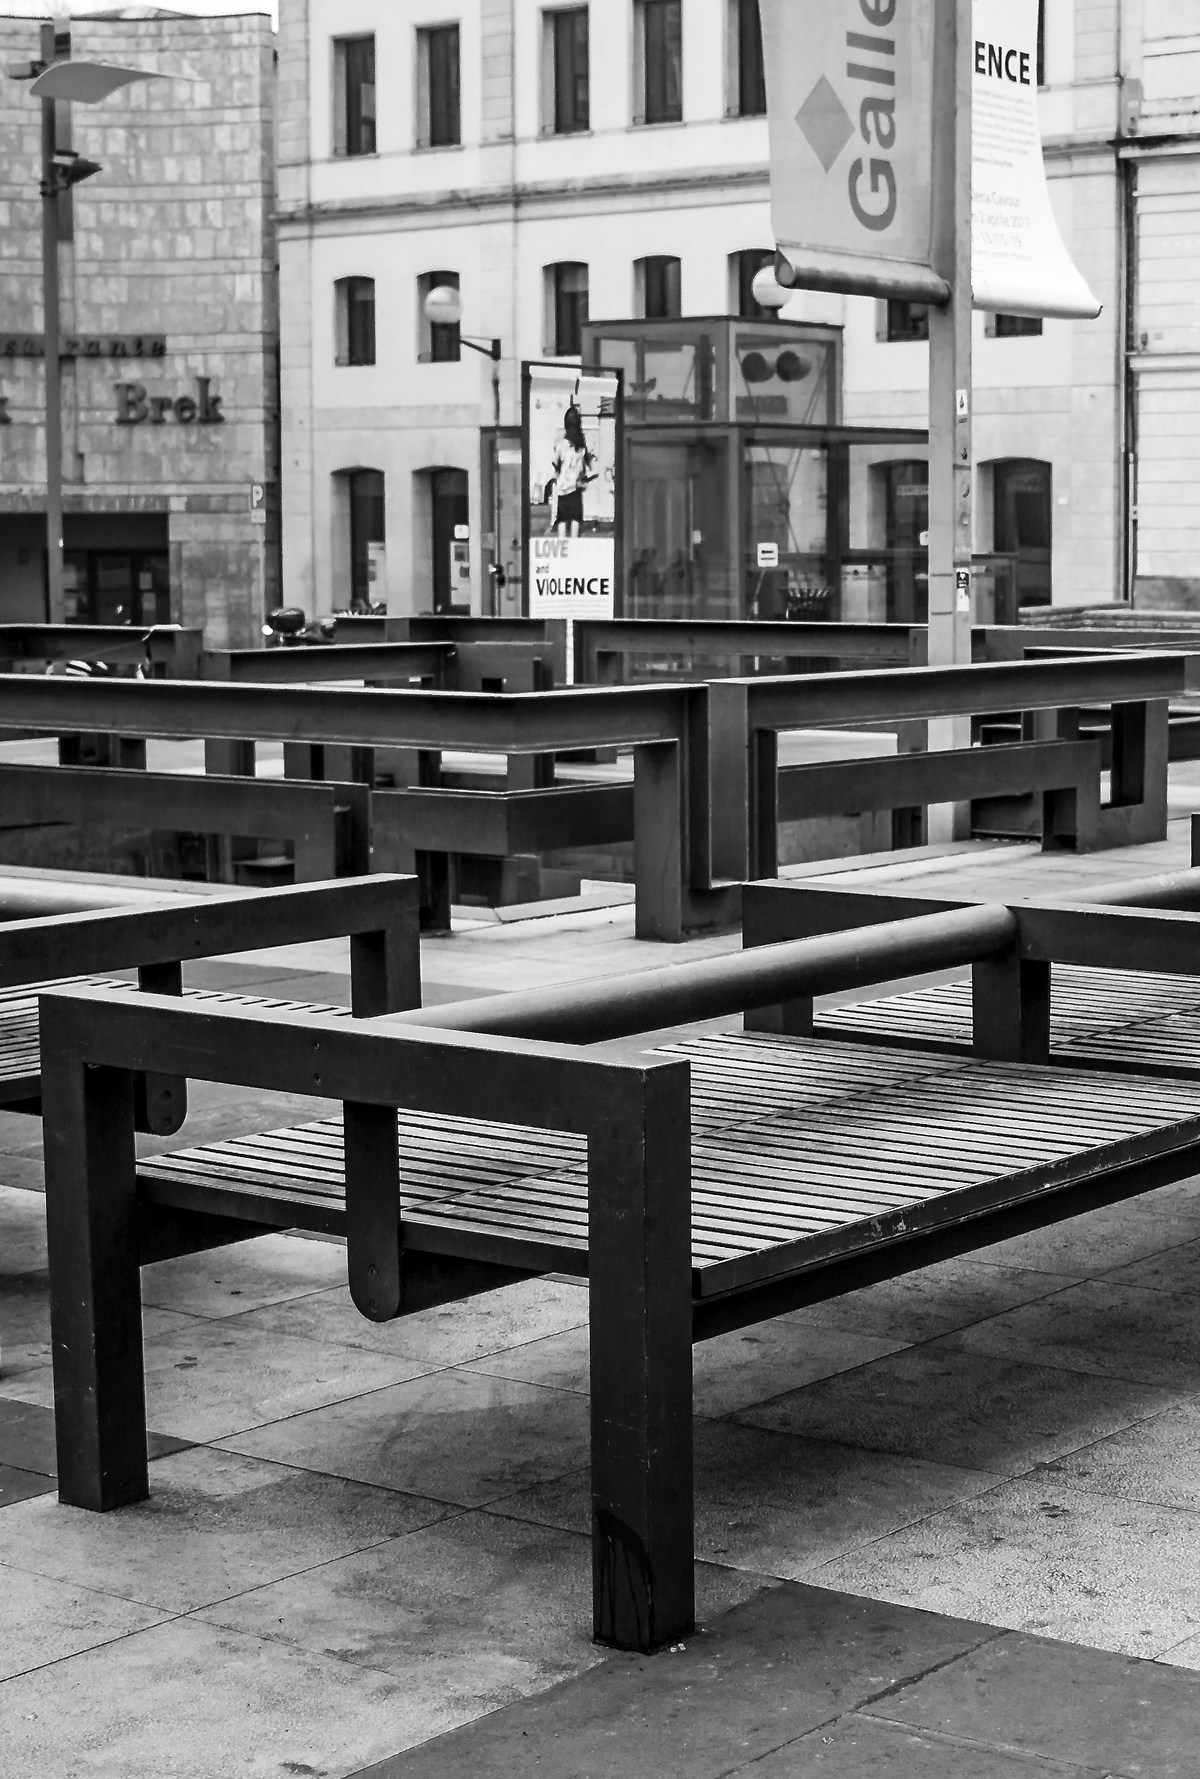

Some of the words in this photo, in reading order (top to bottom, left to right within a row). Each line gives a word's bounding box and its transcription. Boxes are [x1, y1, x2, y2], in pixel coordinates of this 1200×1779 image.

[975, 40, 1030, 85] ENCE
[114, 376, 225, 424] Brek
[535, 539, 569, 558] LOVE
[536, 564, 549, 574] and
[535, 577, 610, 597] VIOLENCE
